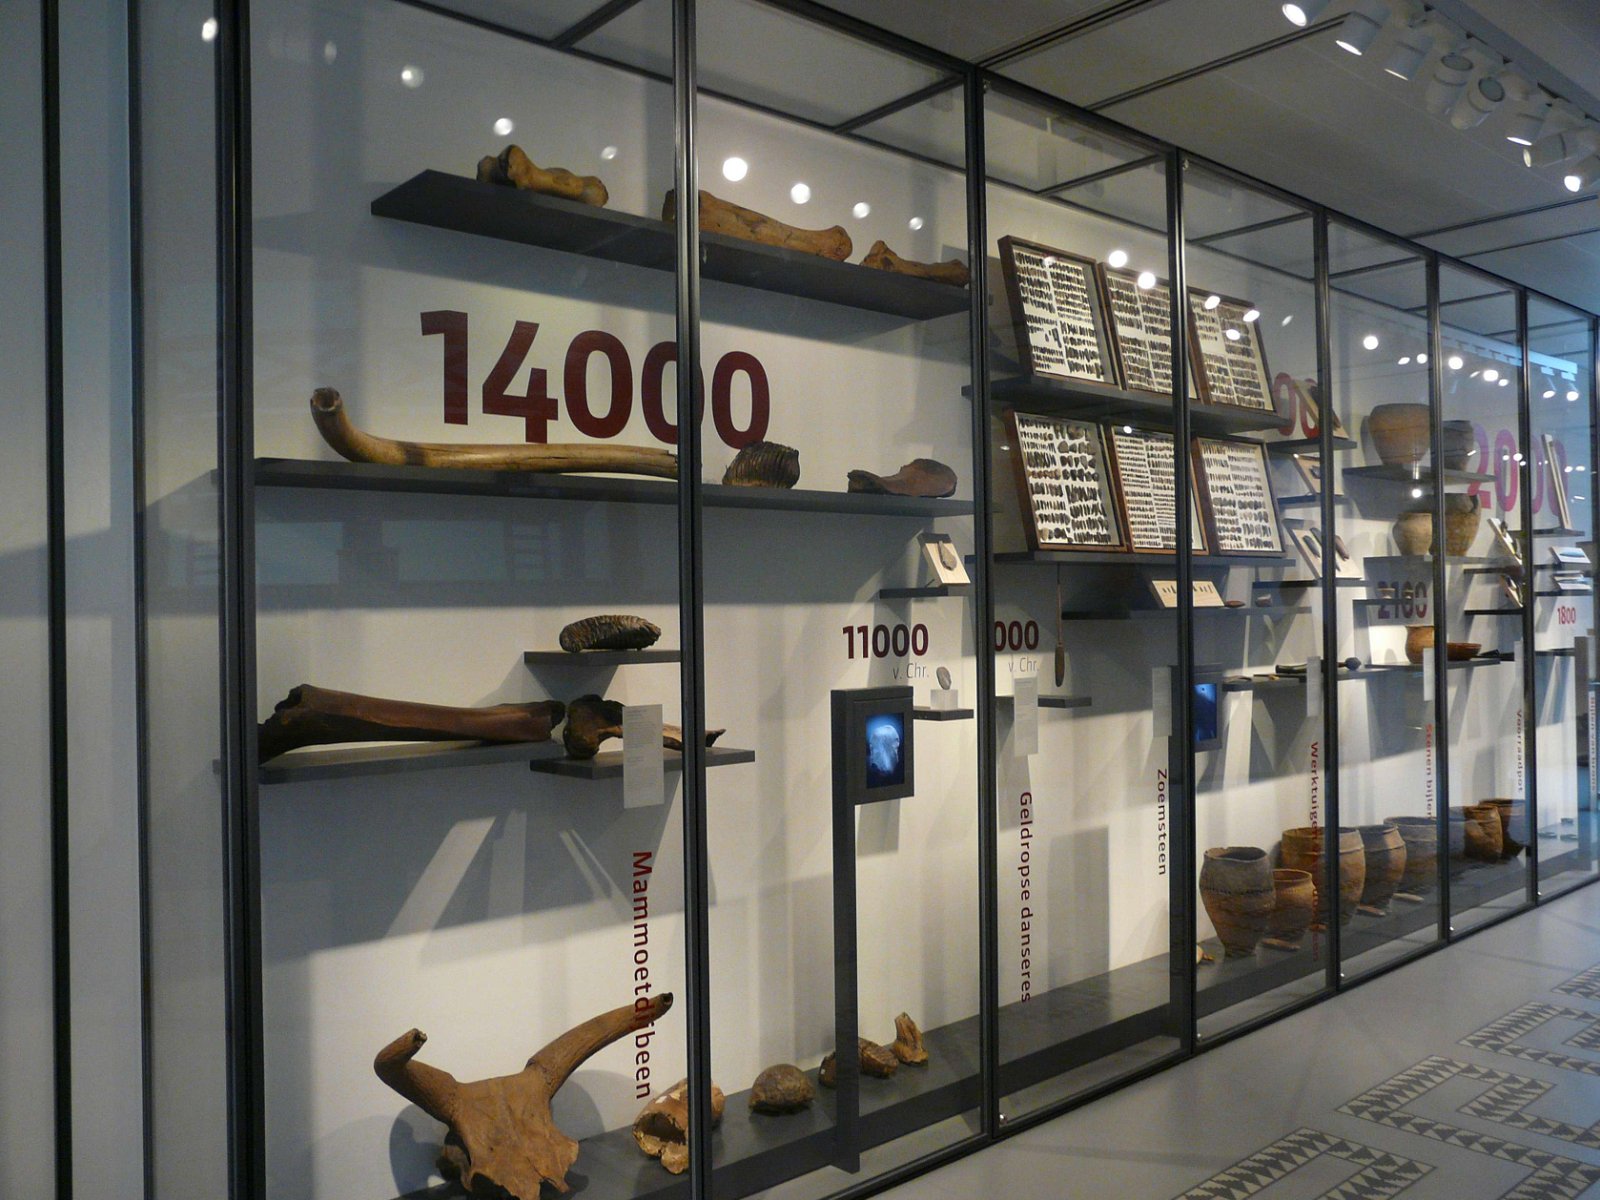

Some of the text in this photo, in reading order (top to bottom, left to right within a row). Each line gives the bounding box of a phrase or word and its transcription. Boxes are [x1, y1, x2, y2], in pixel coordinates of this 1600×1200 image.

[420, 310, 770, 450] 14000
[842, 623, 930, 659] 11000
[1557, 605, 1577, 625] 1800
[892, 663, 930, 680] v. Chr.
[1019, 657, 1040, 673] Chr.
[1157, 768, 1168, 875] Zoemsteen
[1310, 742, 1320, 840] Werktuigen
[1018, 792, 1034, 1004] Geldropse danseres
[632, 851, 655, 1099] Mammoetdijbeen
